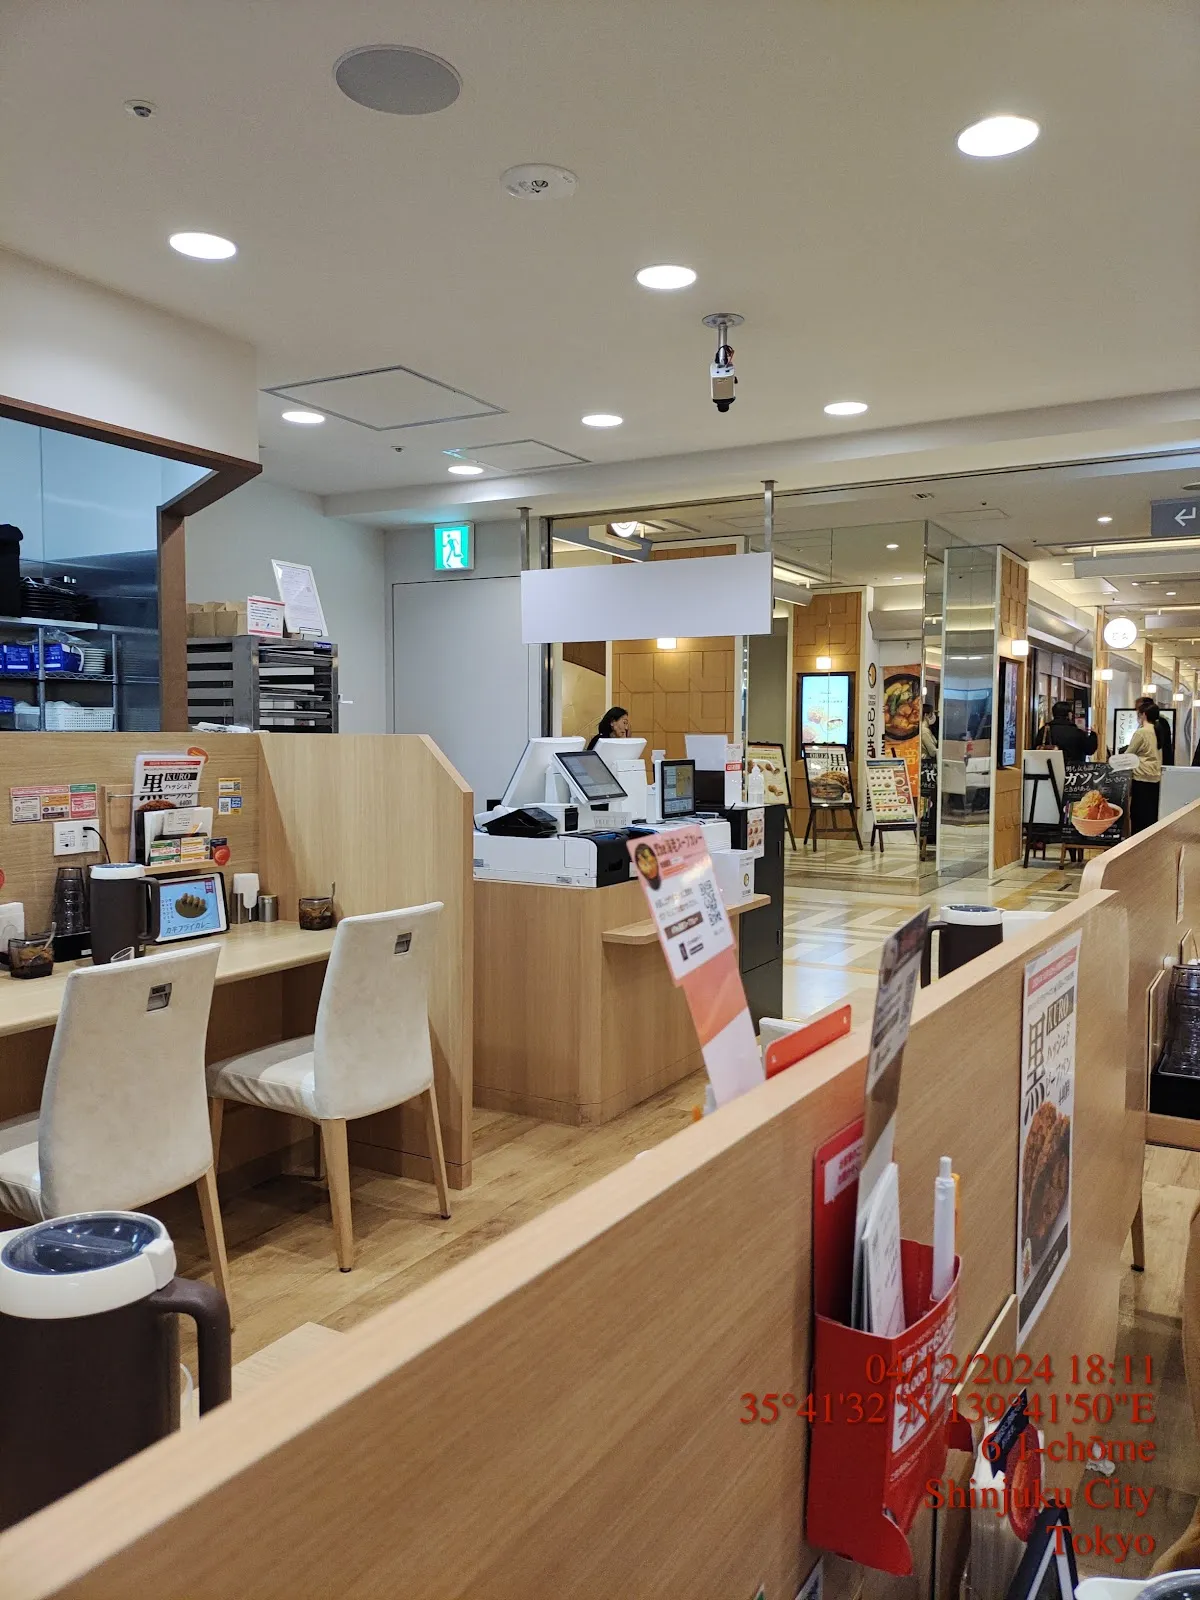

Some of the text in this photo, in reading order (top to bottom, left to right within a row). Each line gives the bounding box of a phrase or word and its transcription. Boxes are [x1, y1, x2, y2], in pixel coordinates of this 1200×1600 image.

[165, 773, 190, 781] KURO
[1047, 994, 1069, 1033] KURO
[1025, 1012, 1046, 1125] 黒
